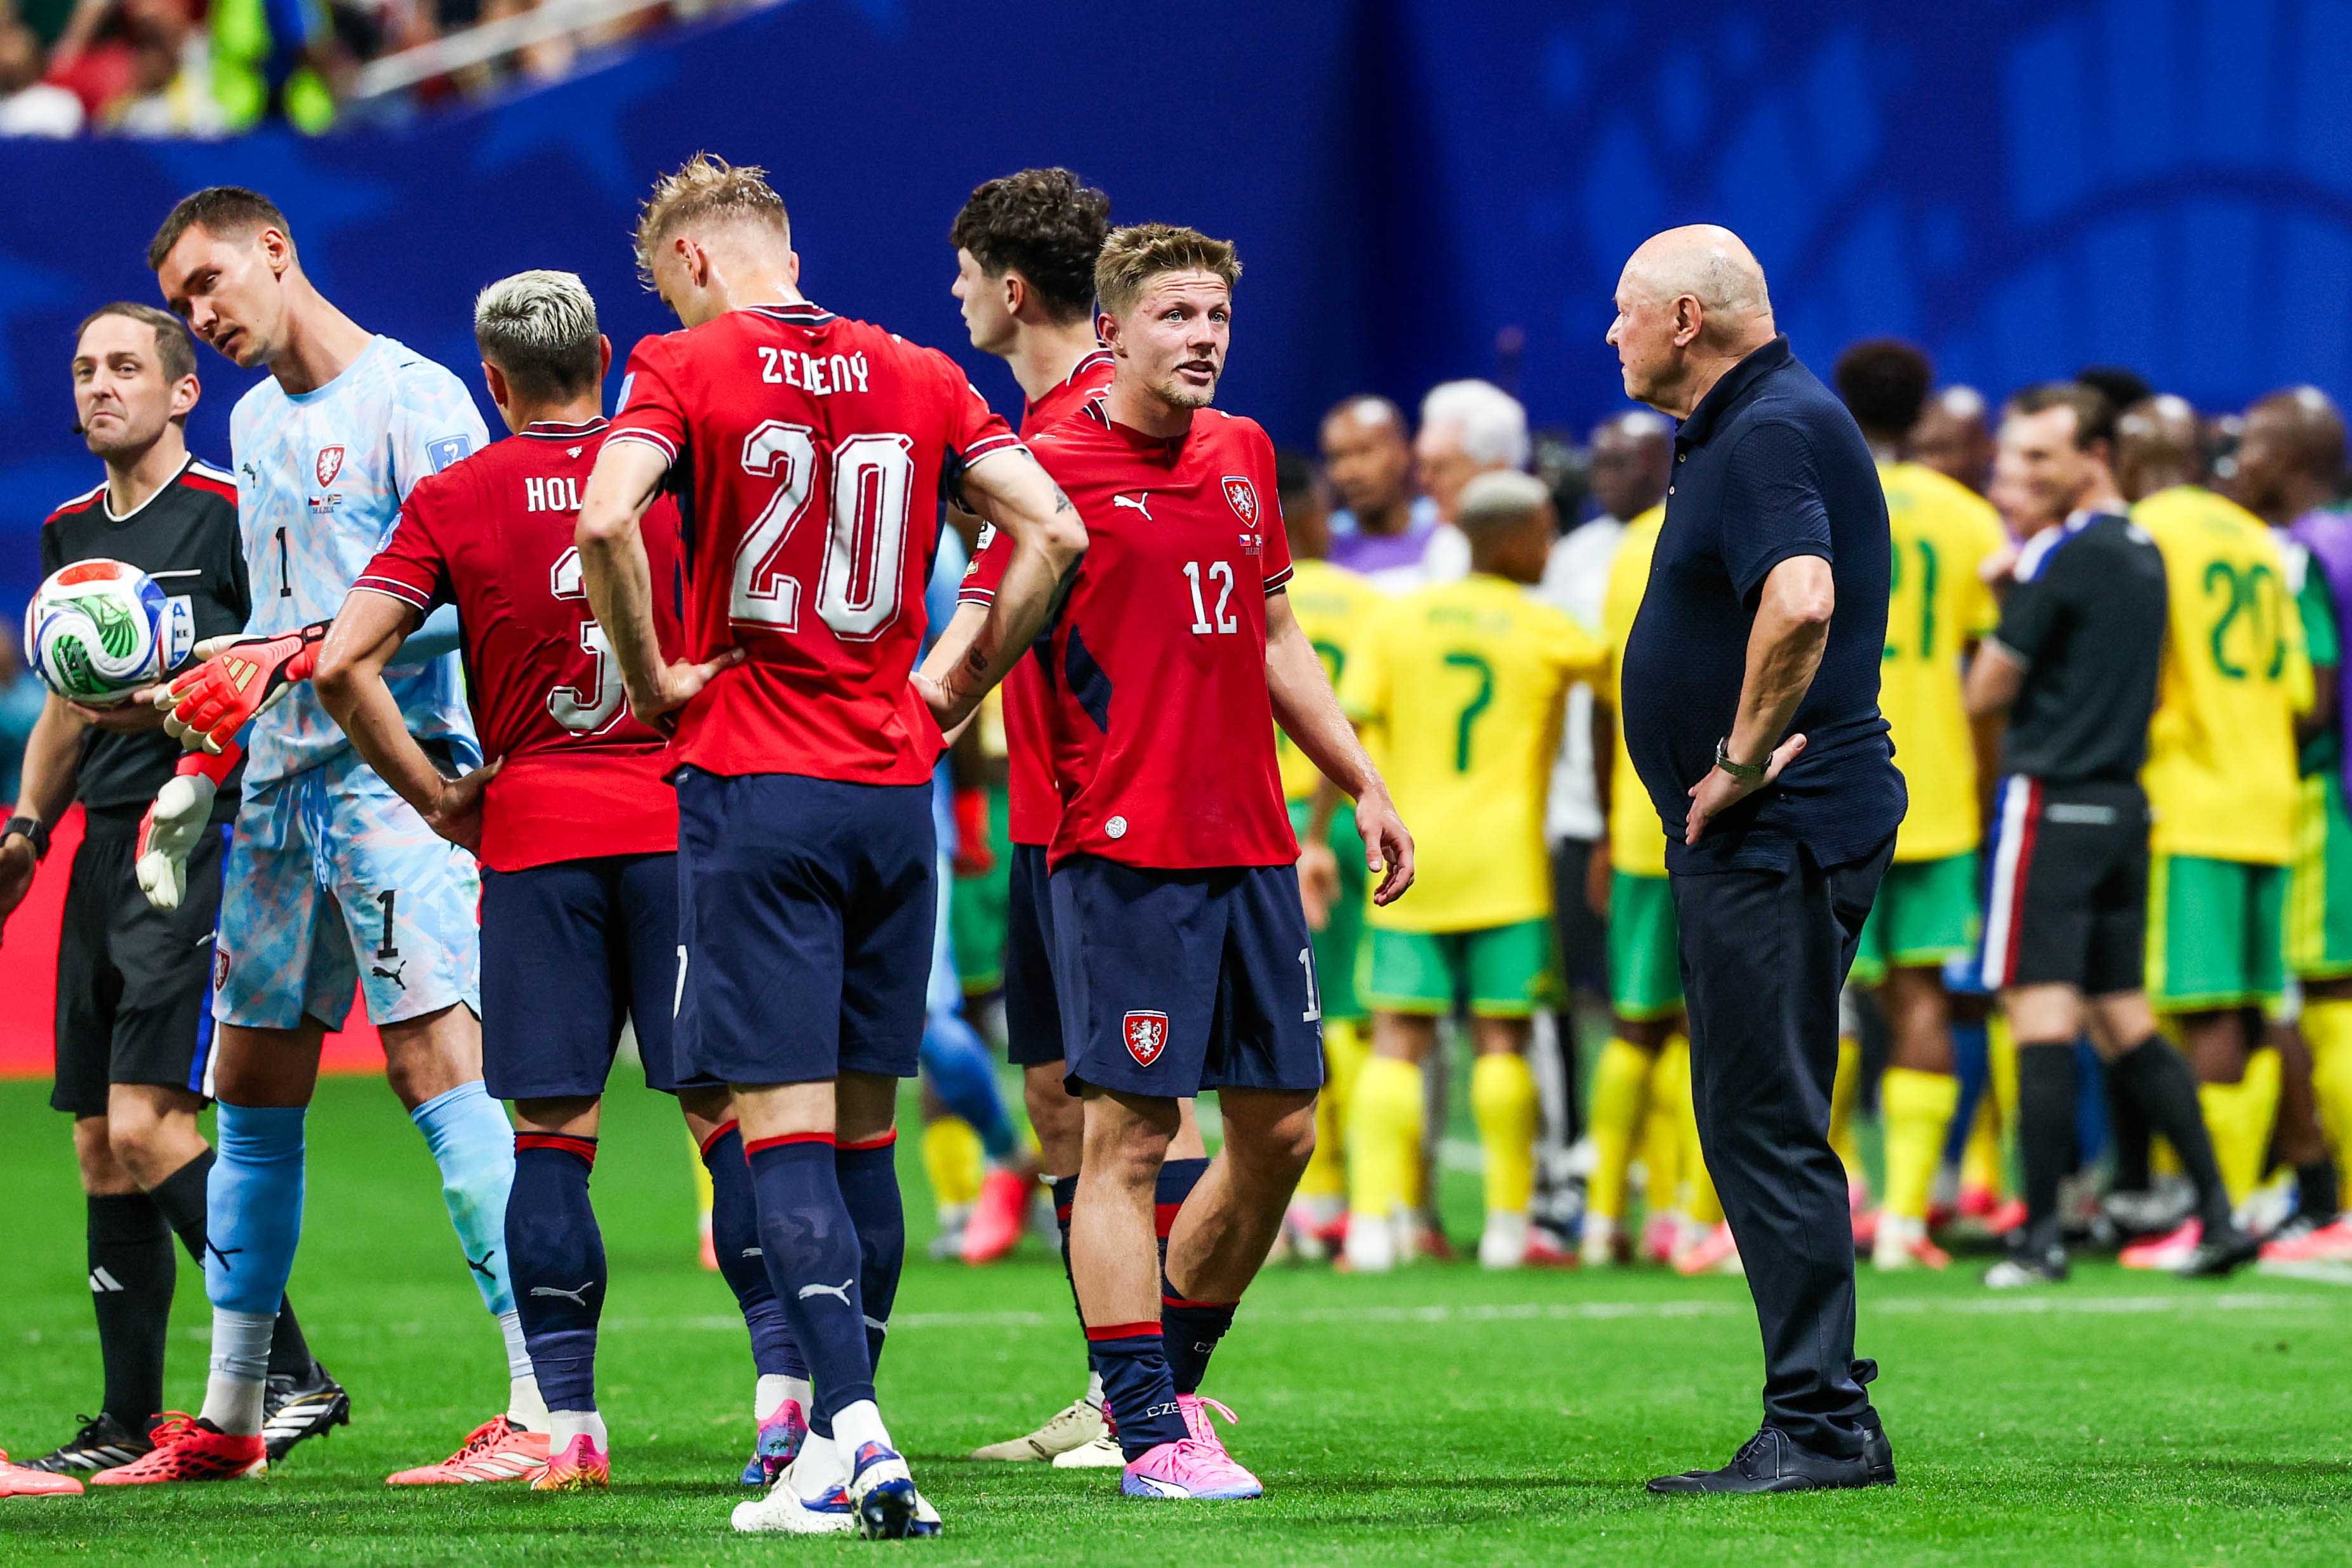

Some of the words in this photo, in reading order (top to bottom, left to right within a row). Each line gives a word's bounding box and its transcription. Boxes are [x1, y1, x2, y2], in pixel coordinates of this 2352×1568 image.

[525, 477, 594, 512] HOL
[729, 419, 914, 642] 20
[276, 526, 291, 597] 1
[1183, 561, 1237, 634] 12
[547, 546, 628, 737] 3
[1445, 652, 1496, 772] 7
[376, 889, 399, 959] 1
[1298, 948, 1321, 1023] 1
[1193, 1342, 1216, 1353] CZ
[1146, 1402, 1181, 1417] CZE
